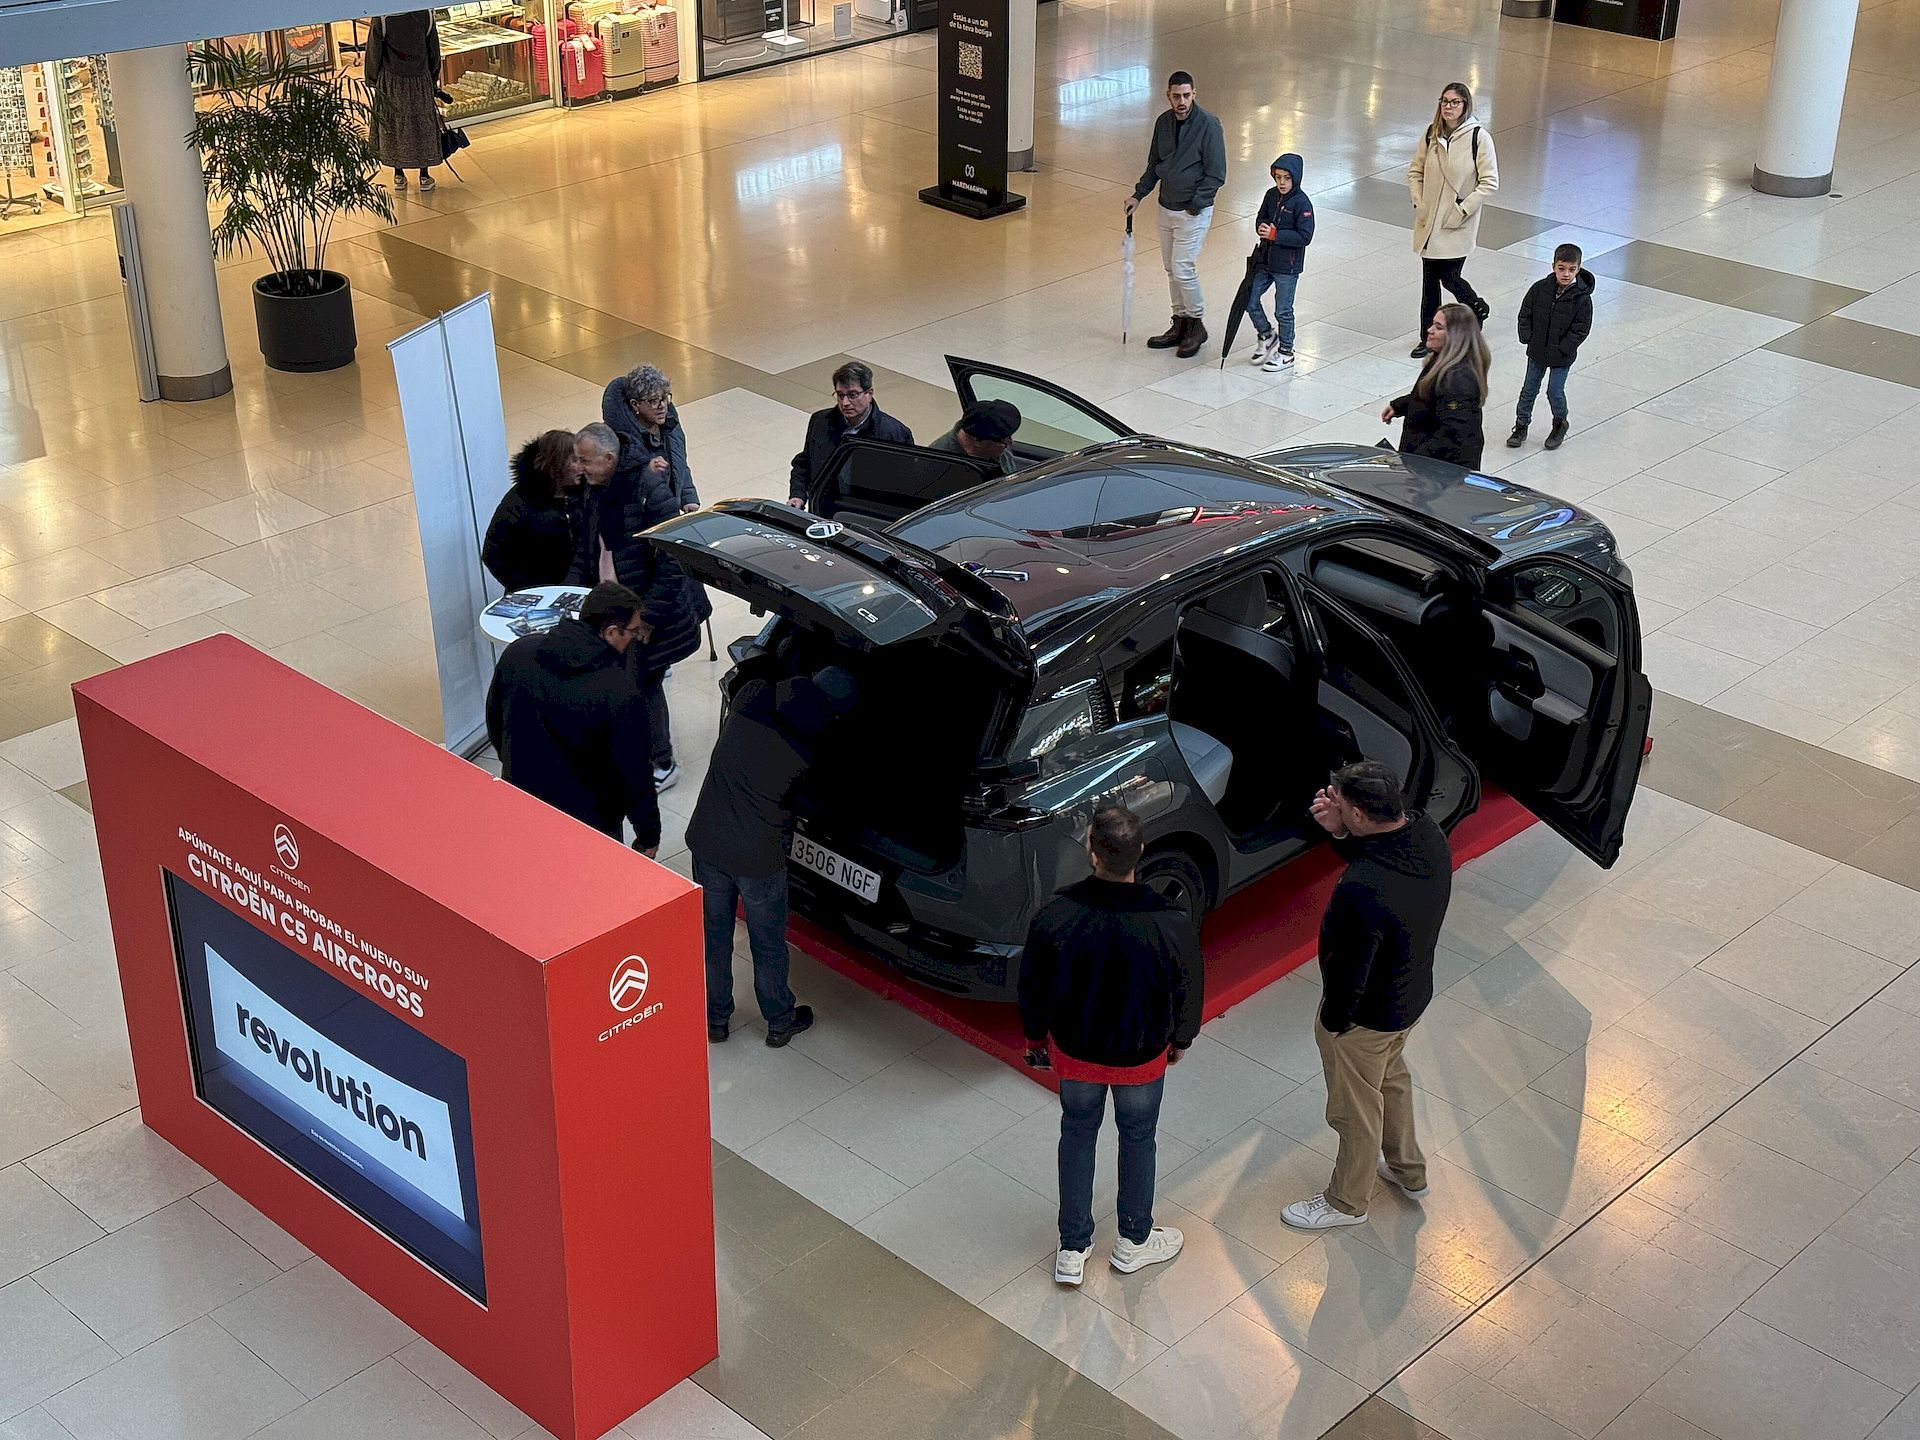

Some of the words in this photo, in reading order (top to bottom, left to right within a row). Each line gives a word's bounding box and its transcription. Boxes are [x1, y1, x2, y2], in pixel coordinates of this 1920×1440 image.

[744, 526, 835, 567] AIRCROSS
[857, 607, 879, 624] C5
[178, 826, 233, 870] APÚNTATE
[234, 861, 262, 888] AQUÍ
[262, 878, 294, 908] PARA
[295, 898, 343, 938] PROBAR
[344, 928, 359, 949] EL
[360, 938, 402, 975] NUEVO
[403, 966, 429, 991] SUV
[795, 839, 836, 876] 3506
[840, 862, 875, 893] NGF
[187, 853, 277, 926] CITROËN
[280, 911, 308, 945] C5
[312, 931, 424, 1018] AIRCROSS
[236, 1002, 426, 1161] revolution
